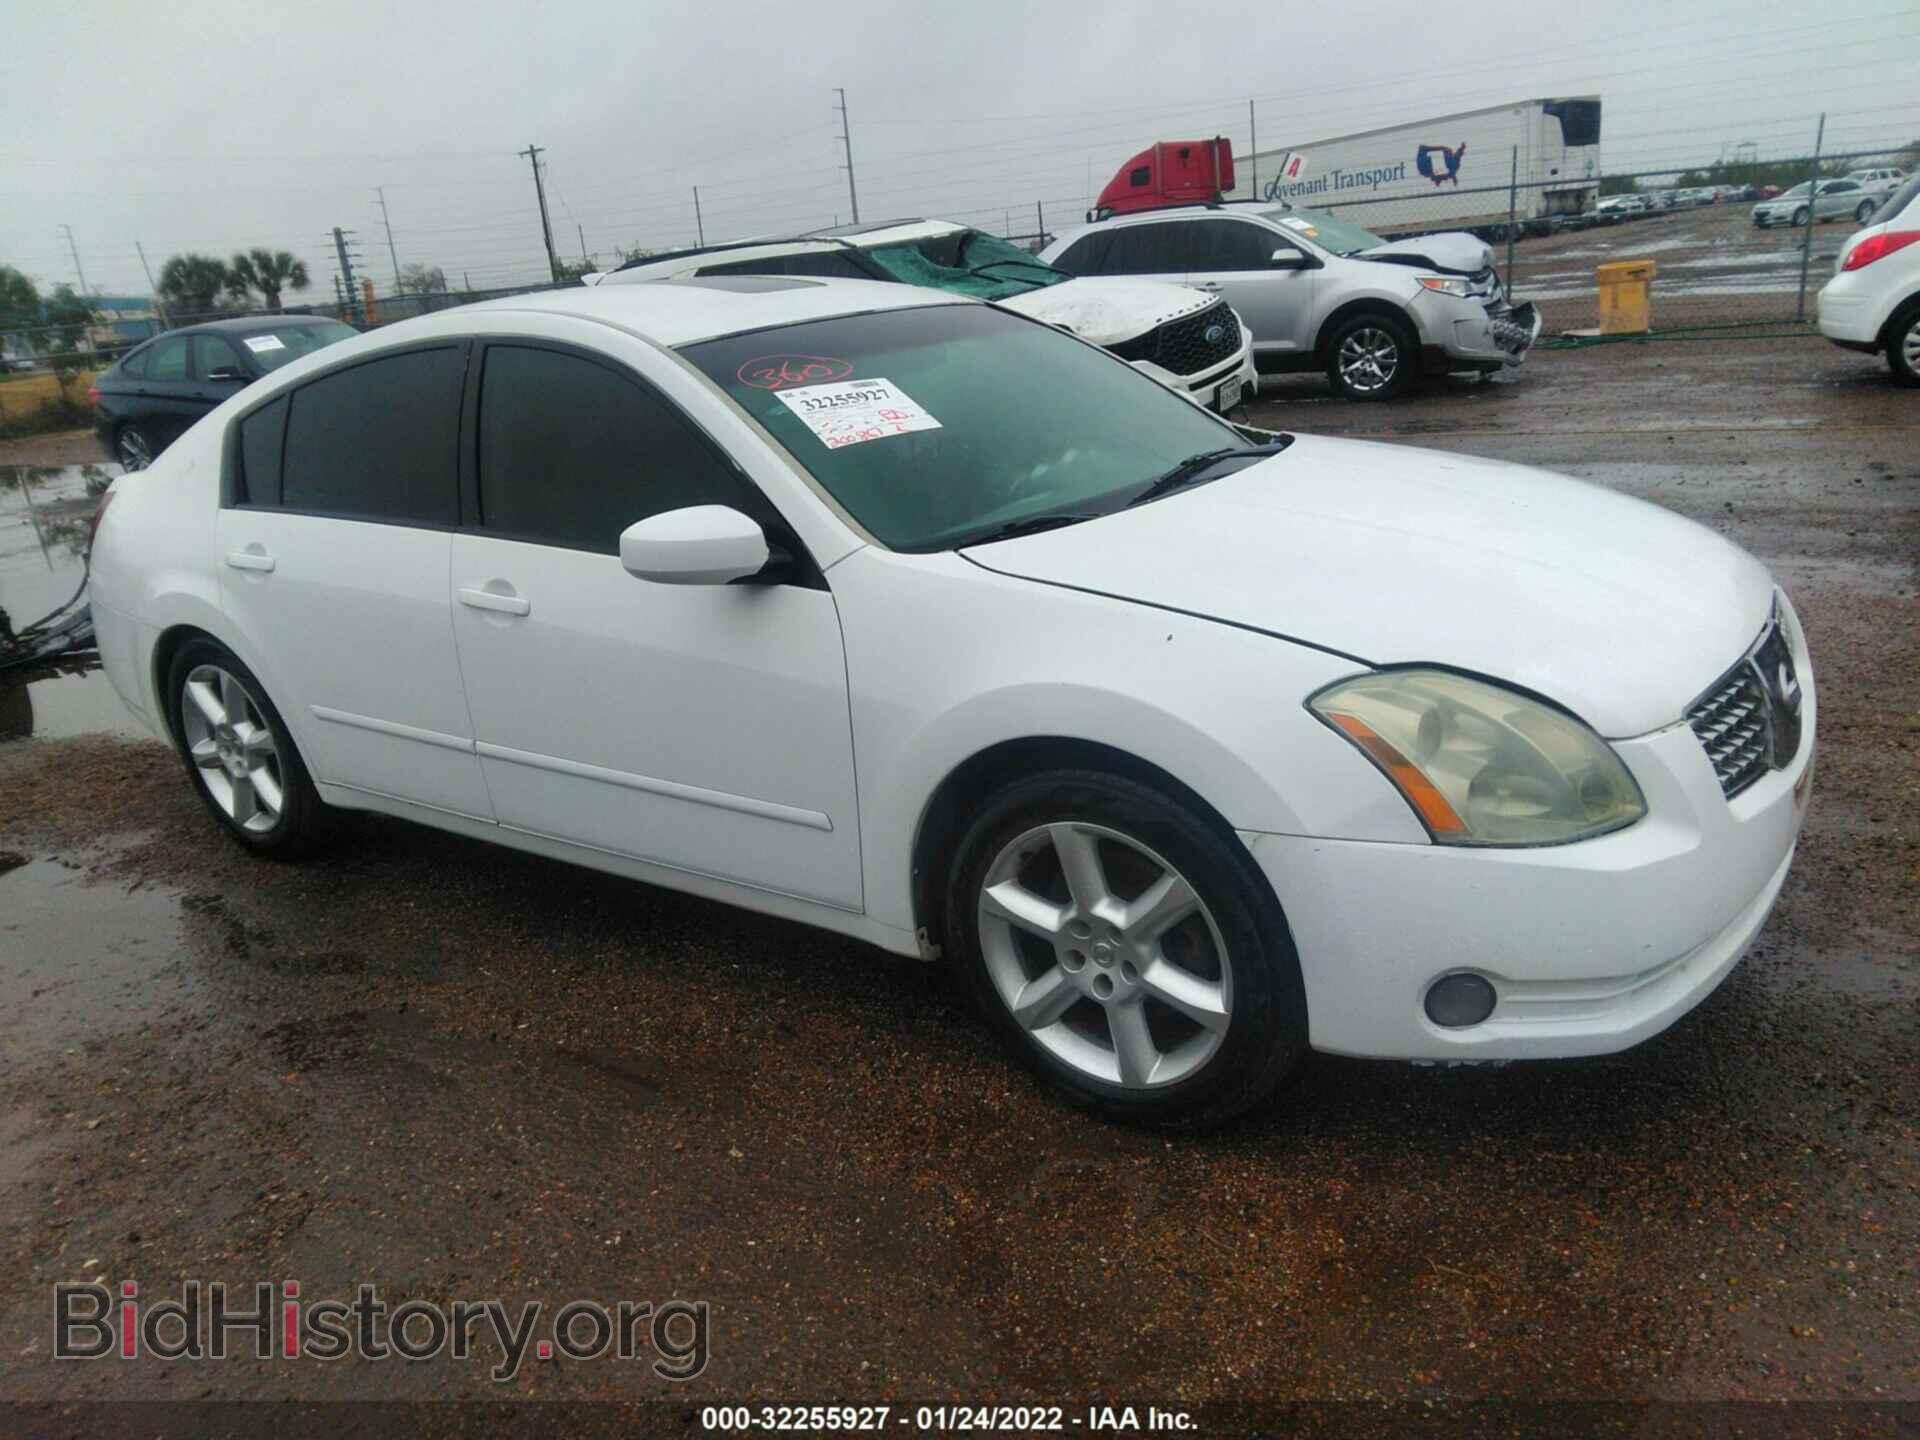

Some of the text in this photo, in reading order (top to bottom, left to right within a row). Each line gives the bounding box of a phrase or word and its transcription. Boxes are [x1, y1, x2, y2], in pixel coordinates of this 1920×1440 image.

[1263, 162, 1405, 200] Covenant Transport
[801, 388, 890, 411] 32255927
